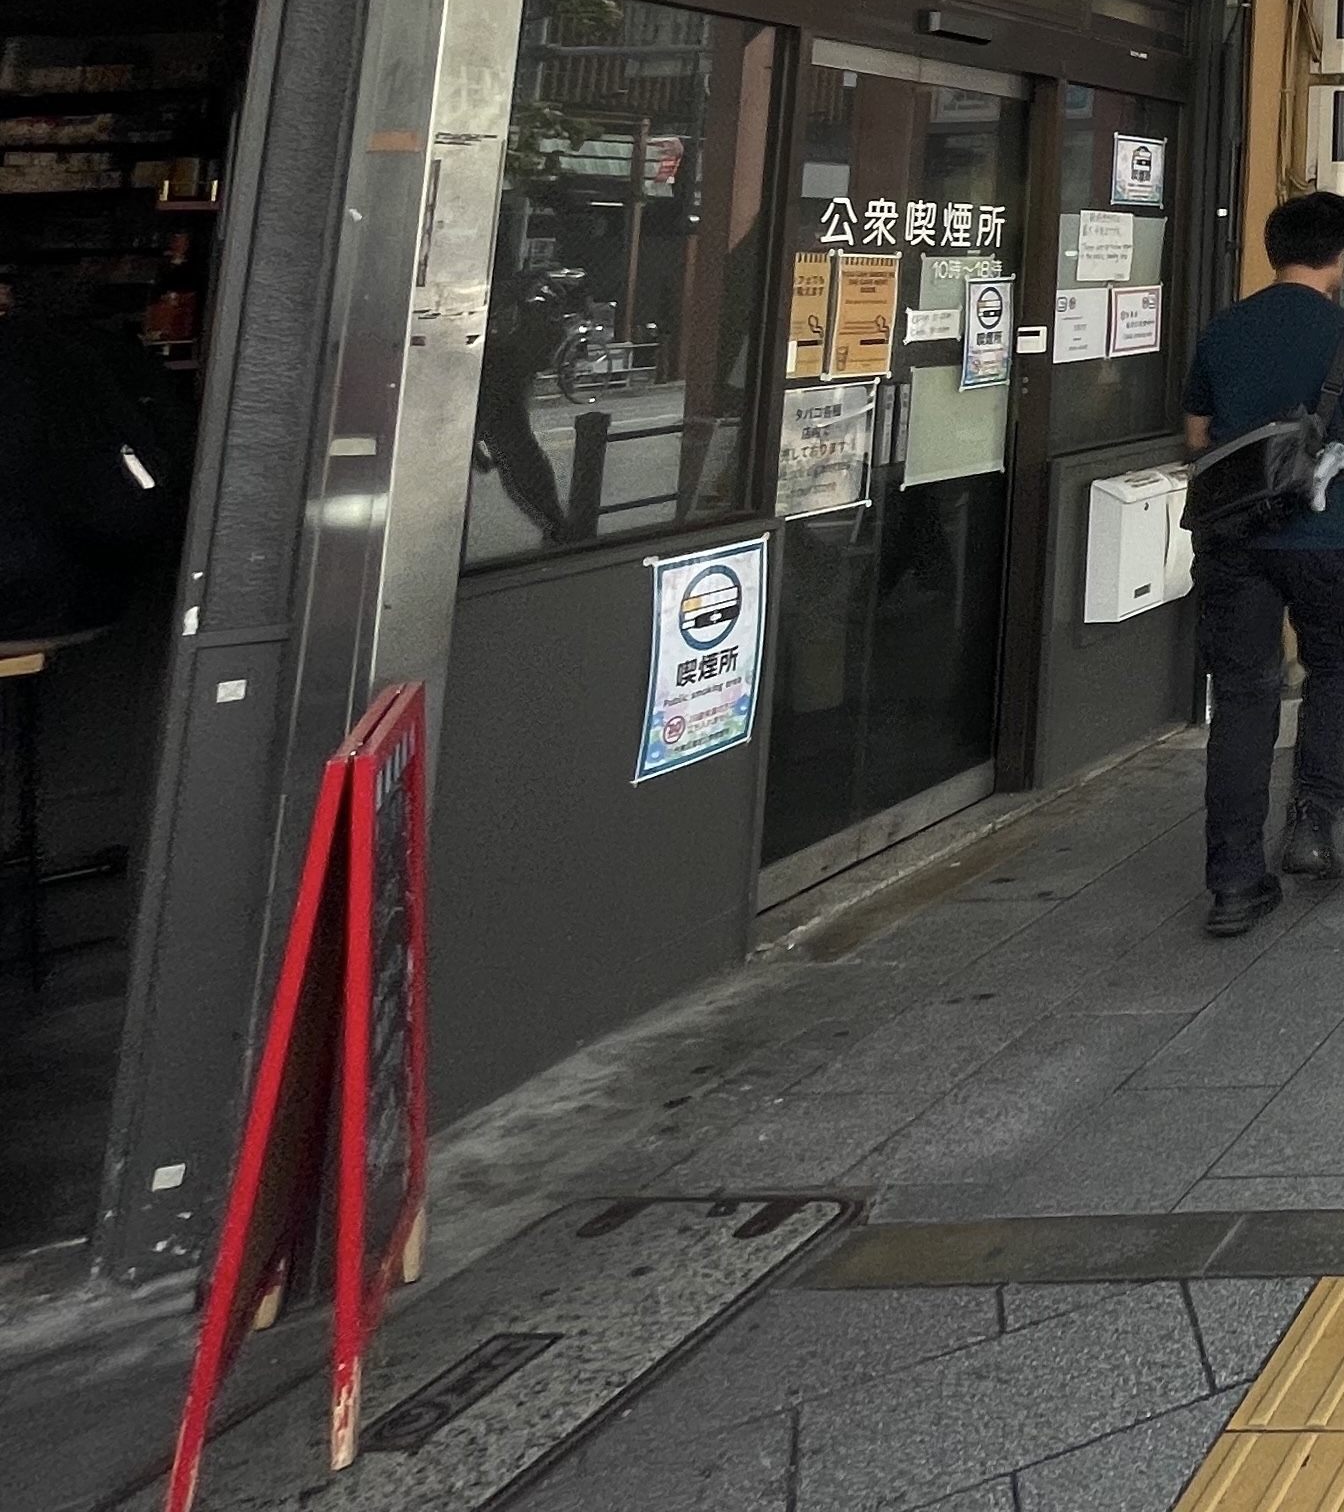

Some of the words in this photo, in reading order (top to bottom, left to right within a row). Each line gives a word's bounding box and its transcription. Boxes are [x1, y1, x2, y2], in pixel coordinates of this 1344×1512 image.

[819, 196, 1007, 249] 公衆喫煙所
[676, 645, 739, 687] 喫煙所
